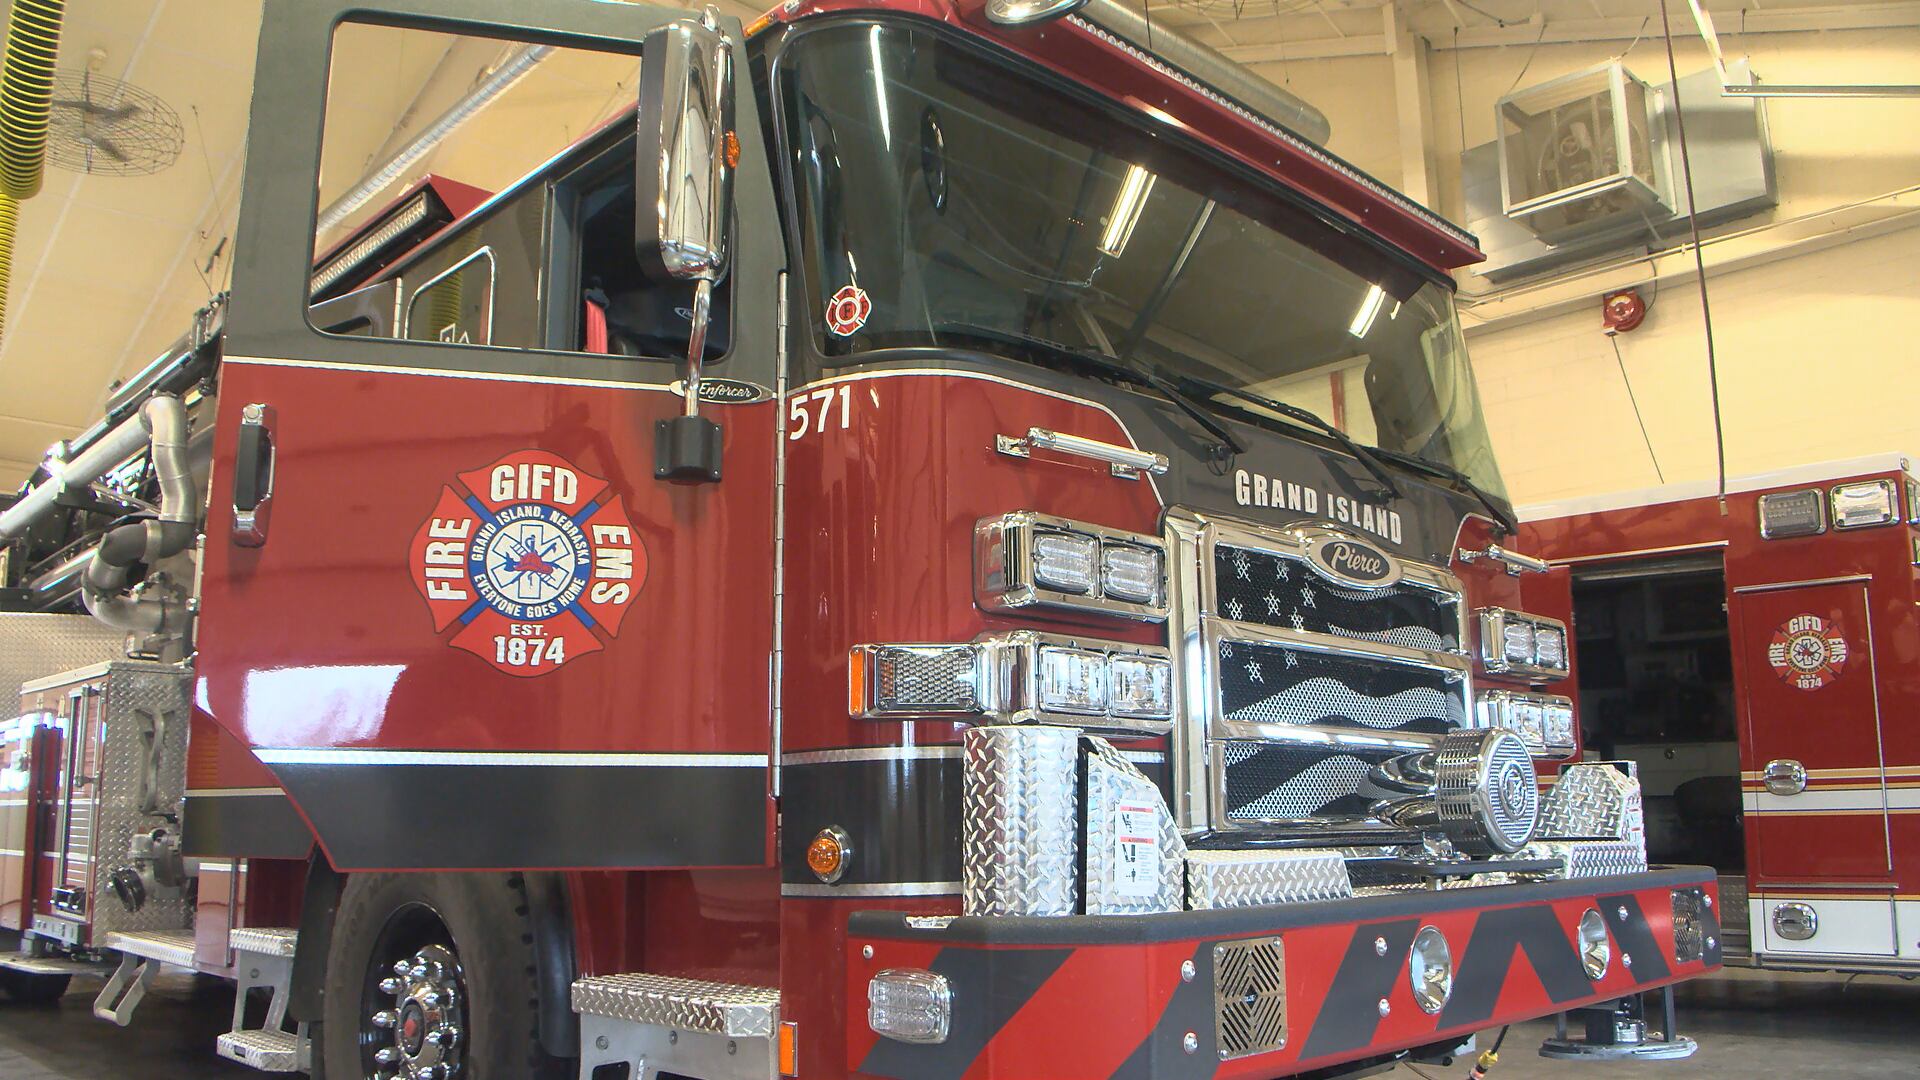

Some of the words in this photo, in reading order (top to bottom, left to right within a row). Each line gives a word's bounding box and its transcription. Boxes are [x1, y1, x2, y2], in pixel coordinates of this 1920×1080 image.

[699, 382, 752, 398] Enforcer
[790, 385, 850, 440] 571
[490, 463, 577, 504] GIFD
[1235, 469, 1318, 514] GRAND
[1327, 493, 1402, 545] ISLAND
[471, 522, 497, 562] GRAND
[495, 505, 545, 526] ISLAND,
[549, 510, 590, 565] NEBRASKA
[425, 517, 472, 601] FIRE
[591, 524, 633, 605] EMS
[1330, 543, 1382, 575] Pierce
[473, 573, 521, 617] EVERYONE
[526, 602, 558, 618] GOES
[557, 577, 586, 607] HOME
[510, 624, 548, 636] EST.
[1788, 616, 1822, 634] GIFD
[494, 636, 565, 666] 1874
[1769, 642, 1788, 667] FIRE
[1827, 637, 1847, 663] EMS
[1796, 678, 1822, 688] 1874
